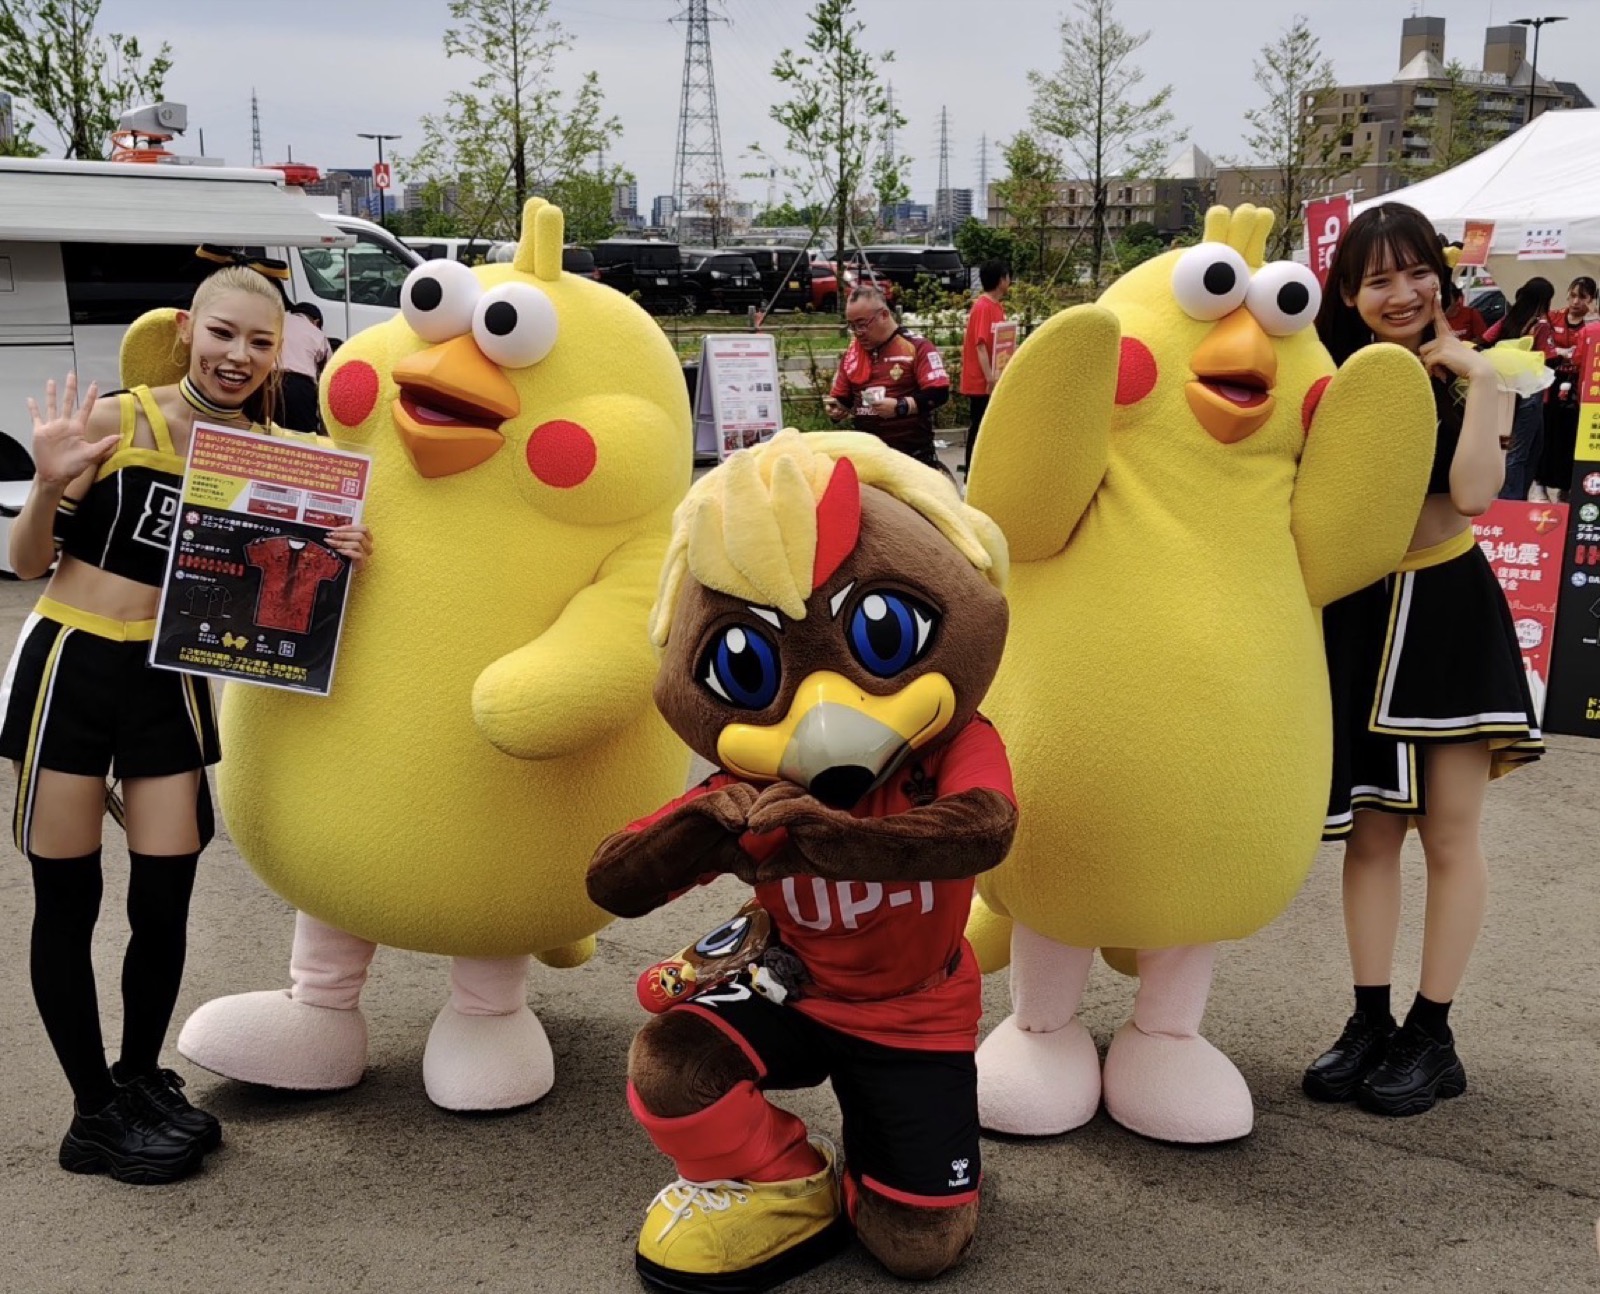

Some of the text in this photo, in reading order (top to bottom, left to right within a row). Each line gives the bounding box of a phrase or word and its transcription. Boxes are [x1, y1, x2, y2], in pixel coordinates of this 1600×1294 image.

[1525, 237, 1559, 247] クーポン
[160, 496, 177, 517] D
[151, 517, 172, 539] Z
[1472, 524, 1504, 538] 和6年
